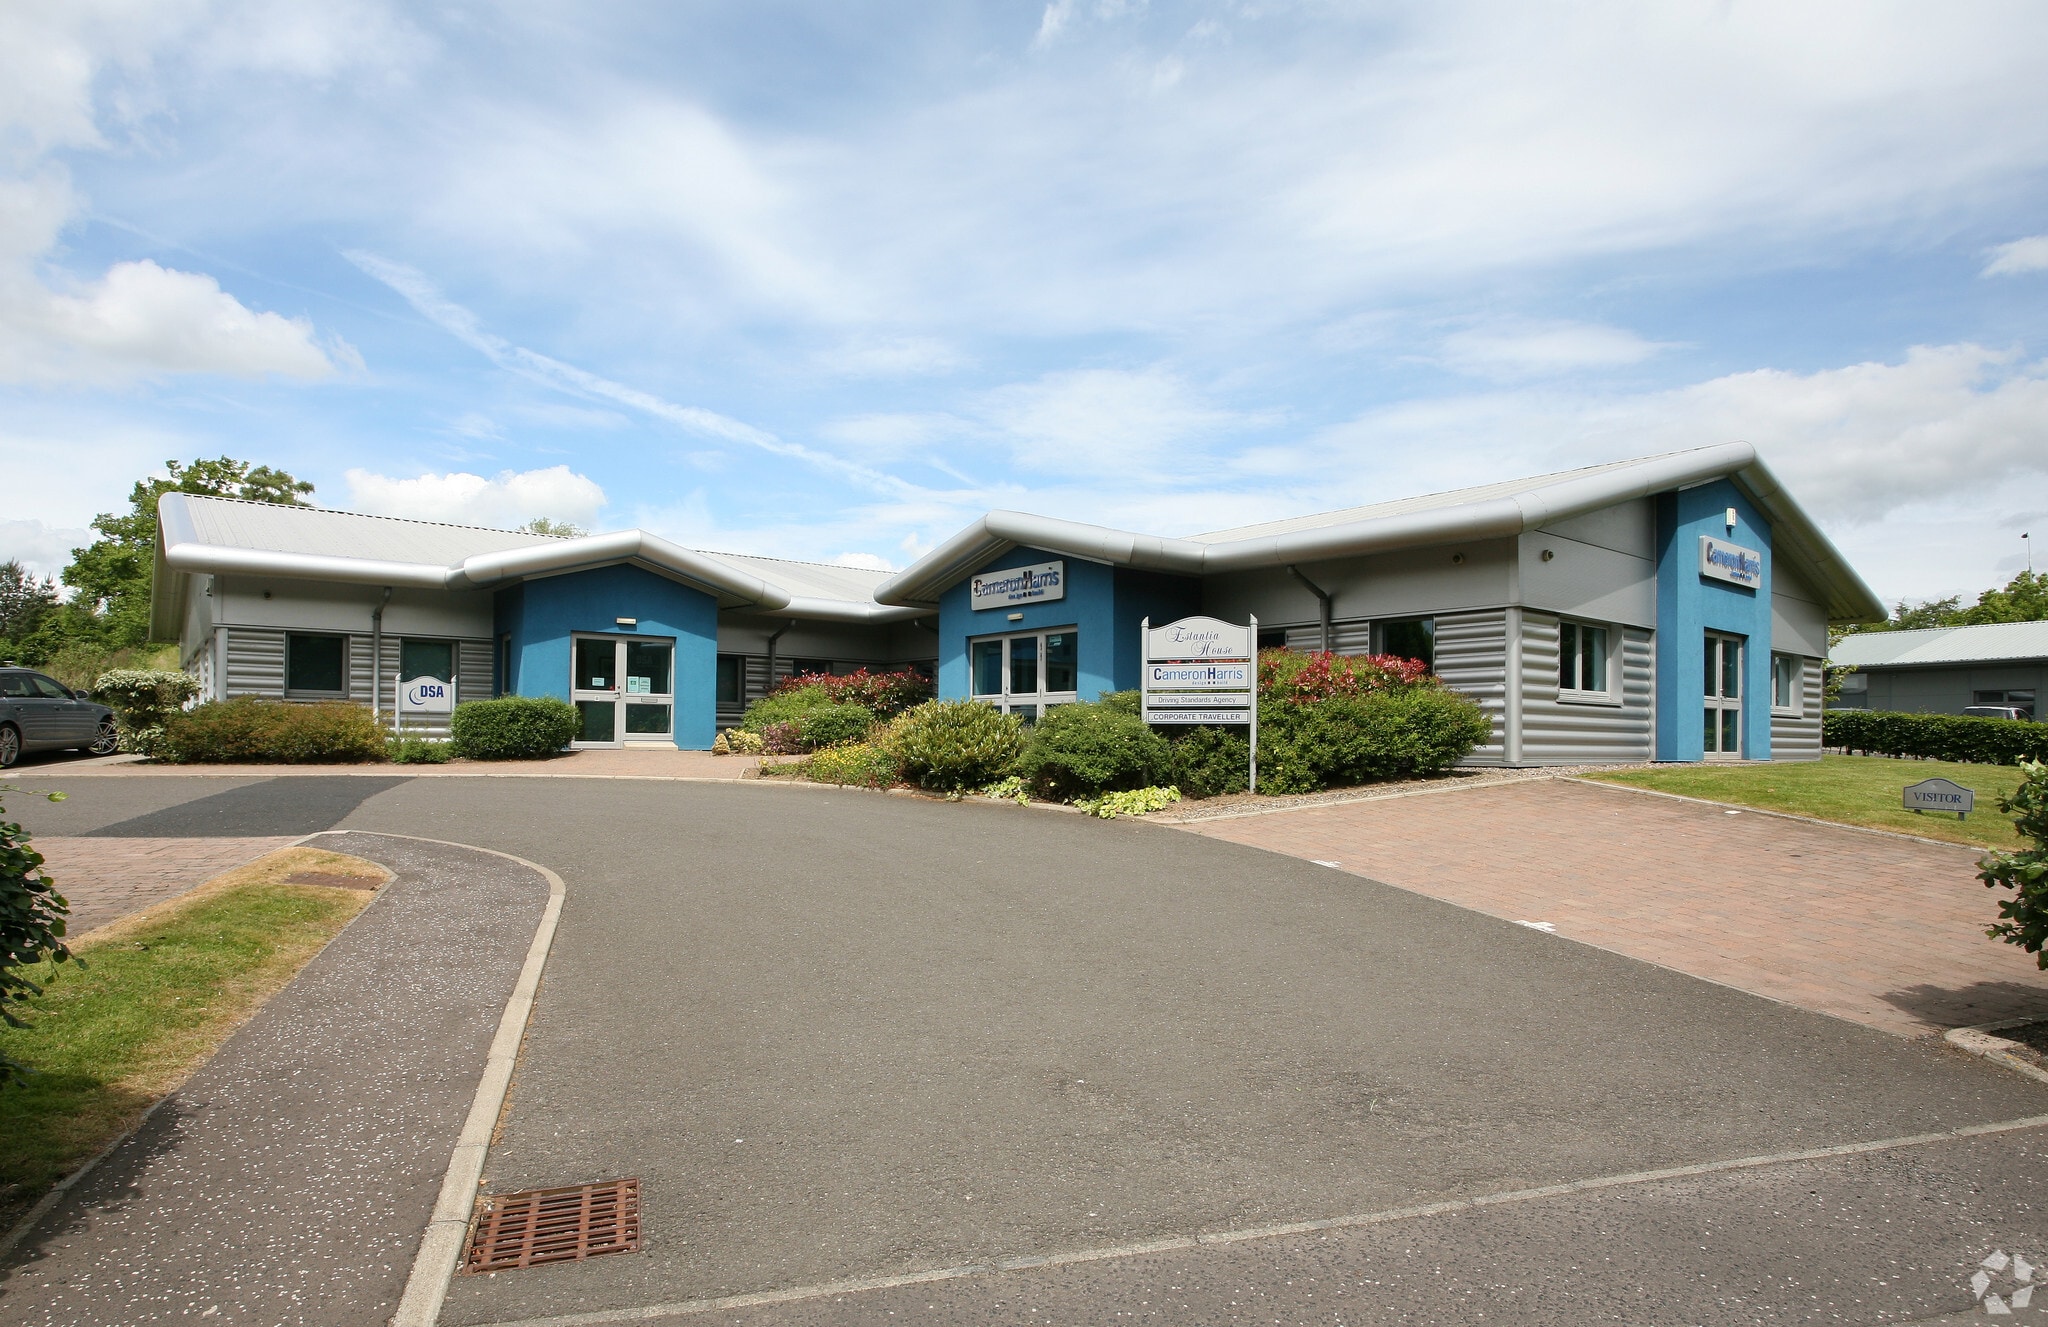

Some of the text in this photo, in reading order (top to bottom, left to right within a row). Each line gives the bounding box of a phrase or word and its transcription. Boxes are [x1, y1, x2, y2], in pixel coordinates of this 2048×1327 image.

[973, 567, 1060, 597] CameronHarris
[1191, 641, 1234, 657] House
[1153, 666, 1243, 680] CameronHarris
[420, 685, 444, 698] DSA
[1158, 696, 1180, 704] Driving
[1212, 696, 1237, 704] Agency
[1913, 792, 1962, 803] VISITOR
